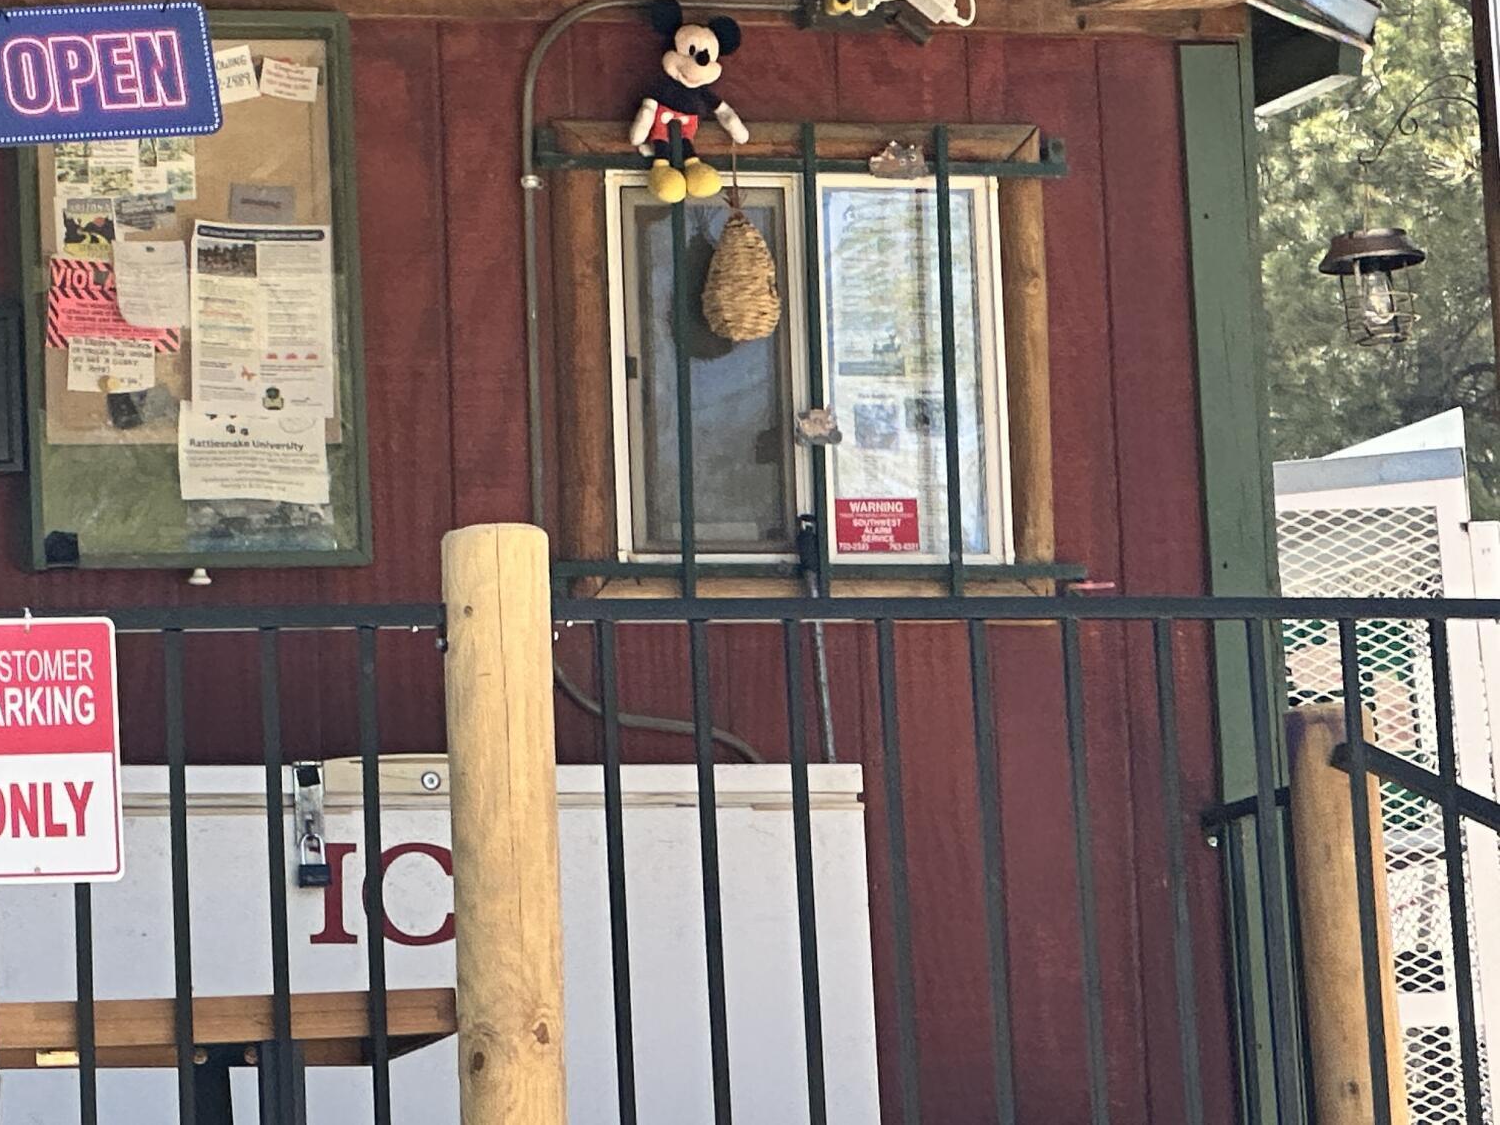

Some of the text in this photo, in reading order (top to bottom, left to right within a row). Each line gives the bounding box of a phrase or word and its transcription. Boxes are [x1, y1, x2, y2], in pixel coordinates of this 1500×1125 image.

[2, 29, 188, 116] OPEN
[189, 438, 304, 452] Rattlesnake University
[849, 501, 904, 512] WARNING
[310, 842, 456, 947] IC
